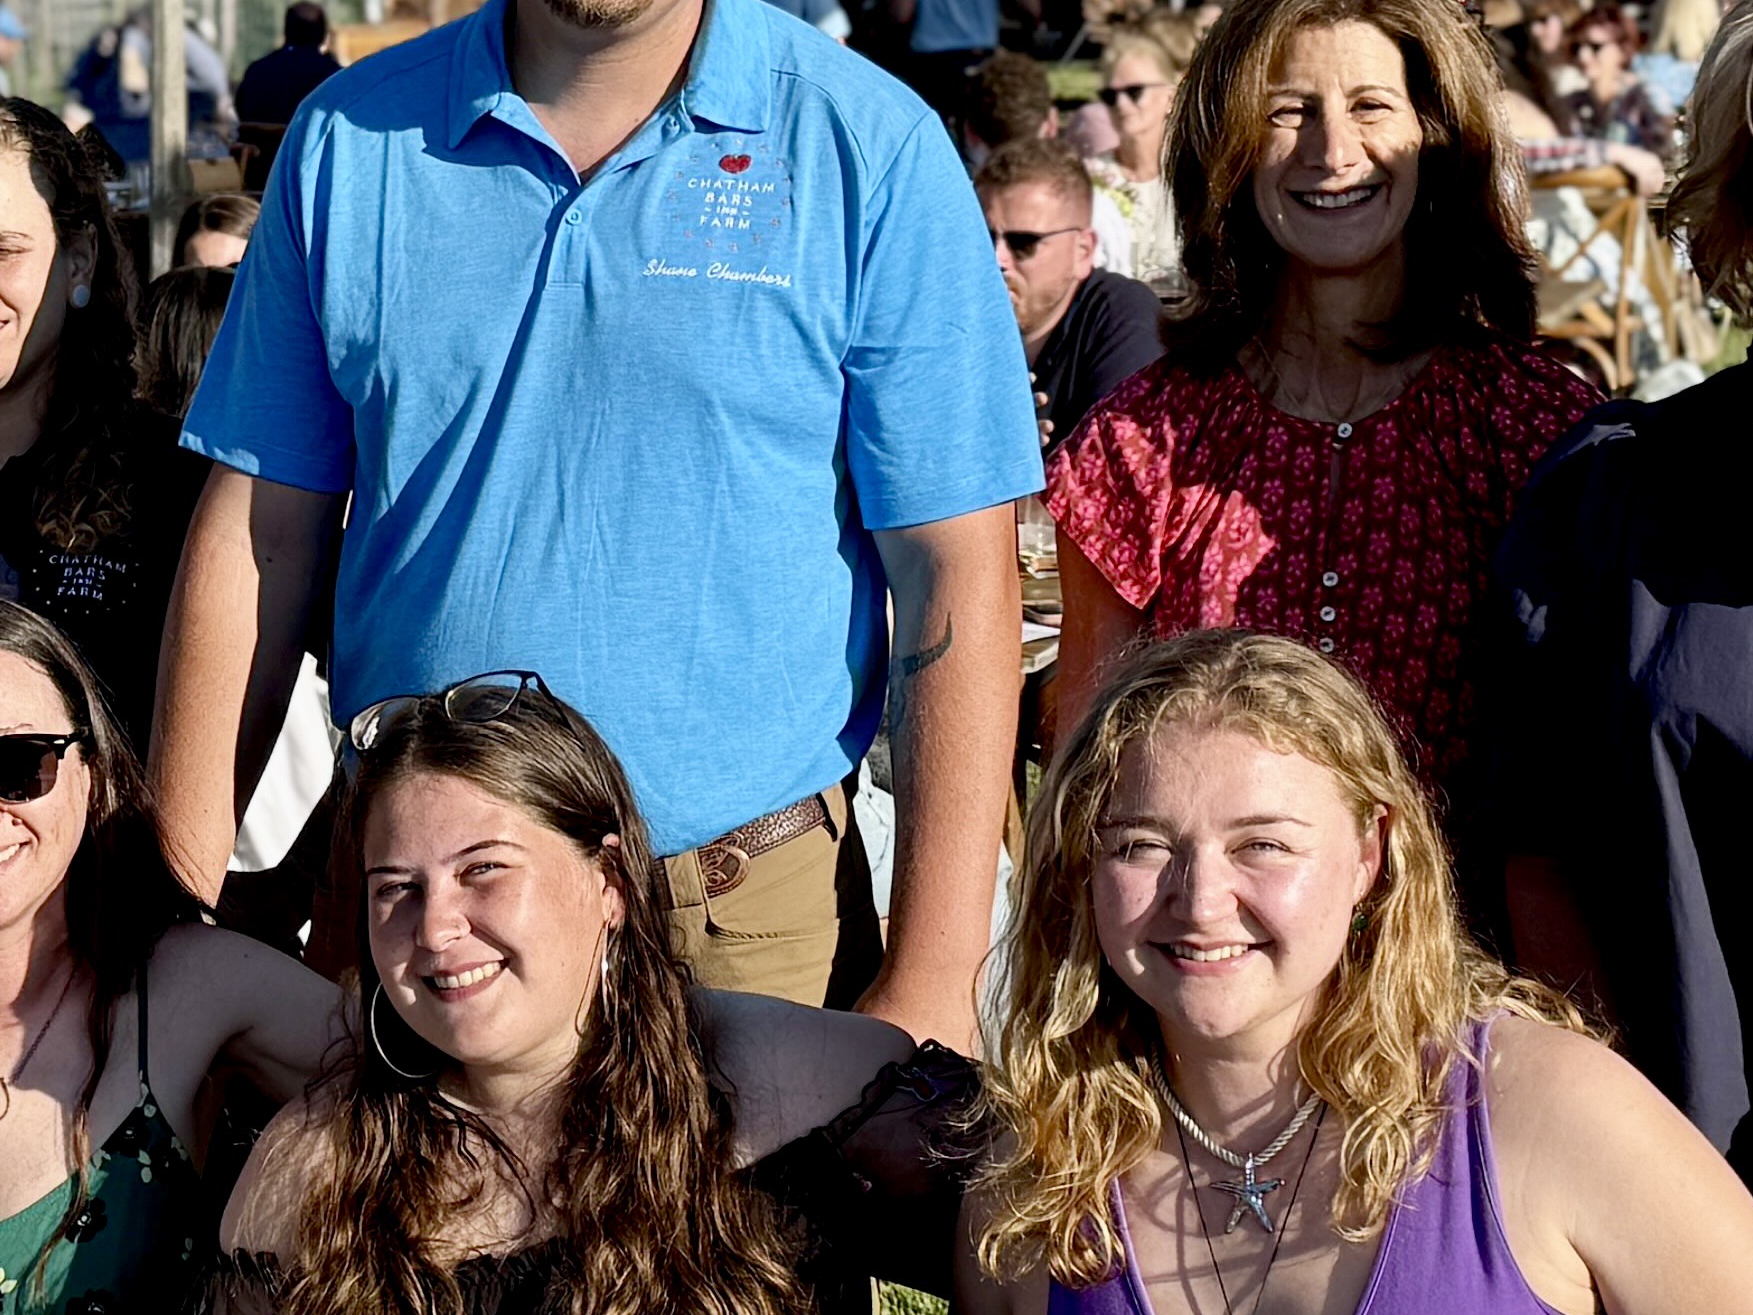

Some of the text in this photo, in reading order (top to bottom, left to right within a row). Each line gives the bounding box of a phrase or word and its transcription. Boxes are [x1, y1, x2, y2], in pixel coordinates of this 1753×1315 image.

[687, 178, 775, 193] CHATHAM
[704, 192, 753, 207] BARS
[699, 216, 751, 229] FARM
[642, 257, 792, 288] Shane Chambers
[48, 554, 127, 574] CHATHAM
[63, 566, 106, 581] BARS
[56, 586, 103, 601] FARM
